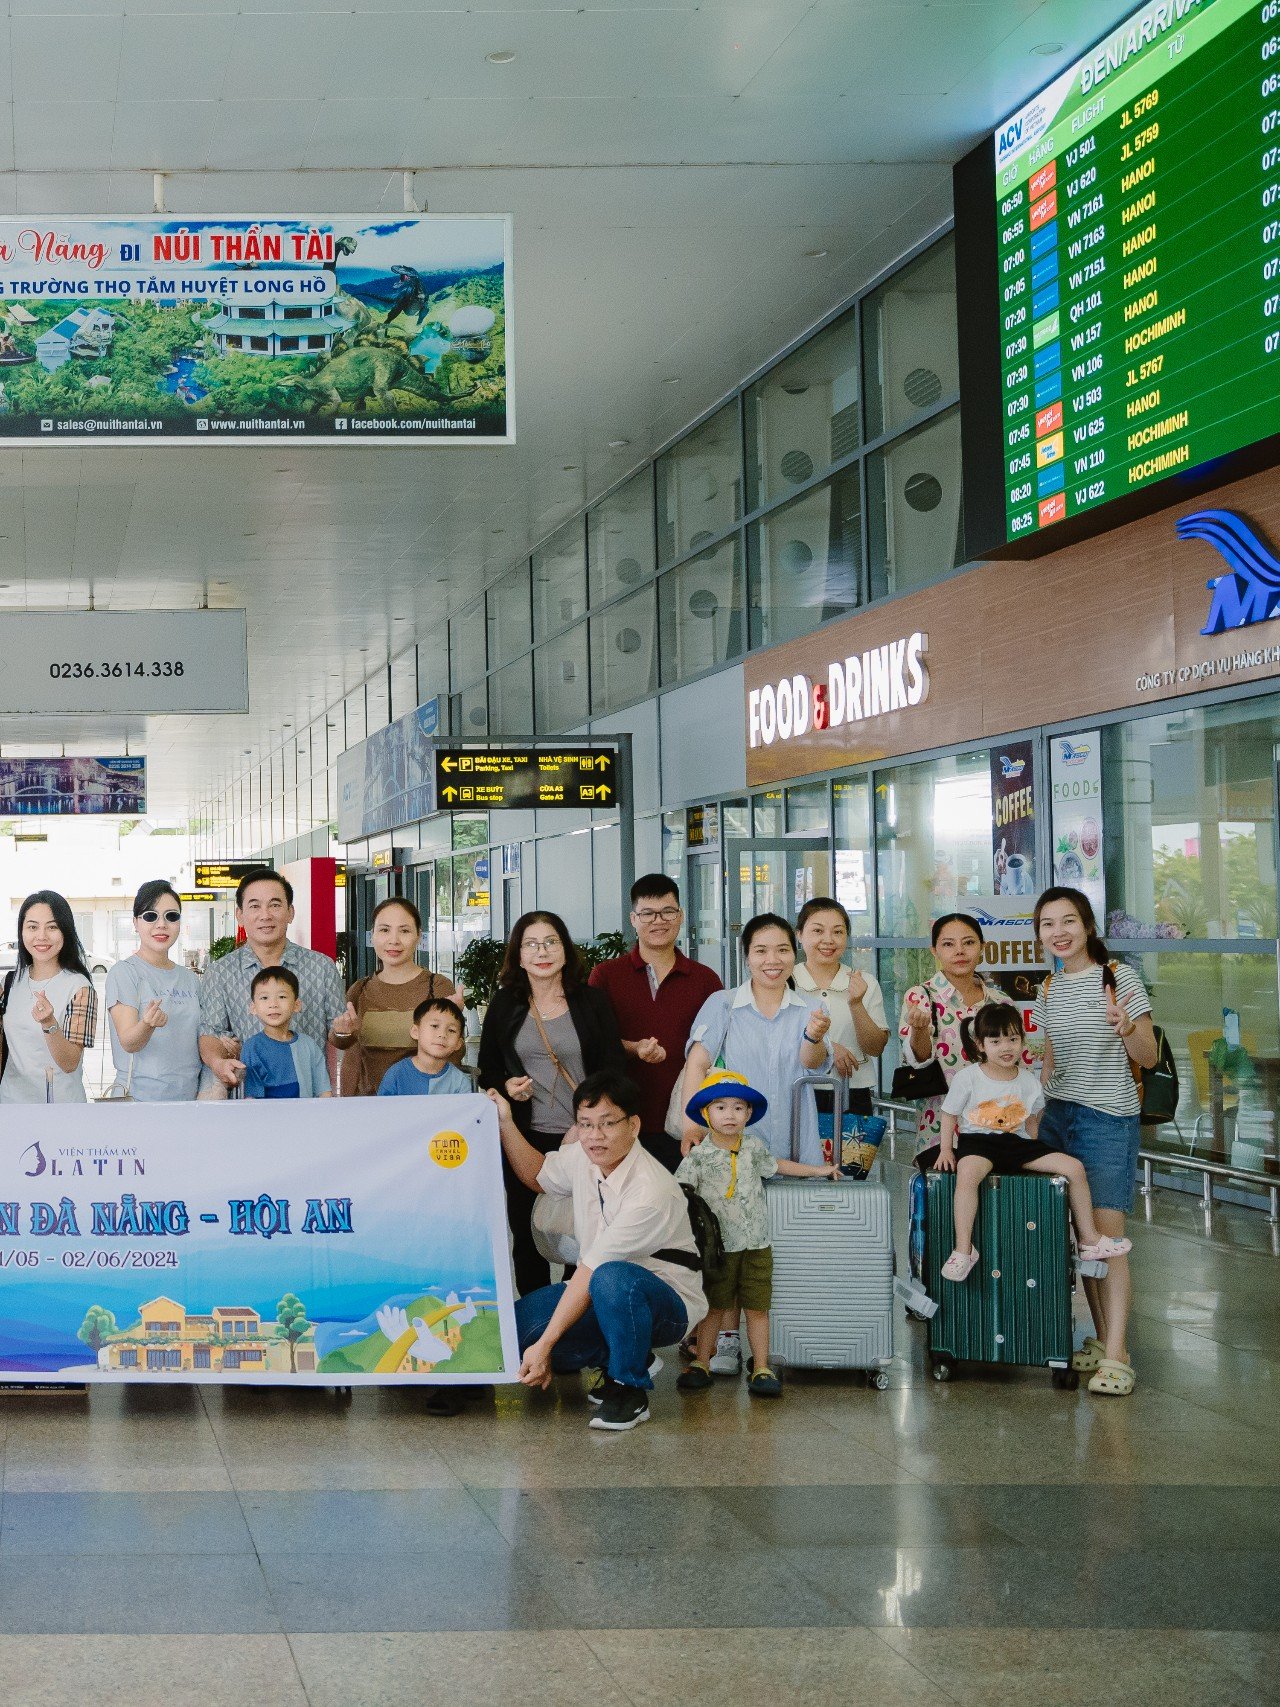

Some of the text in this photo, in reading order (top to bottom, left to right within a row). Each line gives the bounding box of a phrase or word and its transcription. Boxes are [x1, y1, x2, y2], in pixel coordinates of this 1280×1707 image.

[1071, 96, 1106, 134] FLIGHT
[999, 118, 1023, 155] ACV
[1002, 191, 1023, 216] 06:50
[1066, 148, 1078, 168] VJ
[1080, 135, 1096, 158] 501
[1120, 110, 1133, 130] JL
[1134, 90, 1159, 119] 5769
[1002, 219, 1024, 245] 06:55
[1067, 179, 1078, 198] VJ
[1080, 167, 1096, 190] 620
[1121, 143, 1133, 162] JL
[1134, 122, 1160, 151] 5759
[1003, 248, 1025, 273] 07:00
[1067, 207, 1081, 228] VN
[1082, 194, 1105, 222] 7161
[1121, 158, 1155, 193] HANOI
[120, 244, 140, 261] ĐI
[154, 230, 200, 261] NÚI
[210, 226, 280, 260] THẦN
[292, 229, 333, 260] TÀI
[1004, 191, 1156, 301] 07:05 VN 7163 HANOI
[10, 277, 88, 294] TRƯỜNG
[94, 280, 130, 297] THỌ
[137, 276, 175, 293] TẮM
[182, 277, 238, 296] HUYỆT
[244, 280, 294, 293] LONG
[301, 276, 326, 292] HỒ
[1005, 224, 1157, 331] 07:20 VN 7151 HANOI
[1005, 257, 1157, 360] 07:30 QH 101 HANOI
[1006, 291, 1158, 388] 07:30 VN 157 HANOI
[1007, 308, 1186, 417] 07:30 VN 106 HOCHIMINH
[1008, 355, 1164, 446] 07:45 VJ 503 JL 5767
[57, 419, 163, 431] sales@nuithantai.vn
[211, 418, 305, 429] www.nuithantai.vn
[351, 418, 476, 429] facebook.com/nuithantai
[1009, 390, 1160, 475] 07:45 VU 625 HANOI
[1010, 410, 1188, 504] 08:20 VN 110 HOCHIMINH
[1011, 445, 1189, 533] 08:25 VJ 622 HOCHIMINH
[50, 661, 185, 679] 0236.3614.338
[1164, 671, 1175, 685] TY
[1179, 666, 1193, 682] CP
[1193, 661, 1214, 681] DỊCH
[1232, 650, 1261, 670] HÀNG
[749, 674, 811, 748] FOOD
[828, 632, 929, 727] DRINKS
[462, 760, 470, 769] P
[995, 786, 1033, 827] COFFEE
[1054, 780, 1090, 799] FOOD
[51, 1159, 145, 1176] LATIN
[59, 1146, 84, 1156] VIỆN
[30, 1197, 82, 1236] ĐÀ
[91, 1193, 190, 1236] NẴNG
[228, 1193, 292, 1240] HỘI
[301, 1198, 354, 1233] AN
[62, 1250, 178, 1268] 02/06/2024
